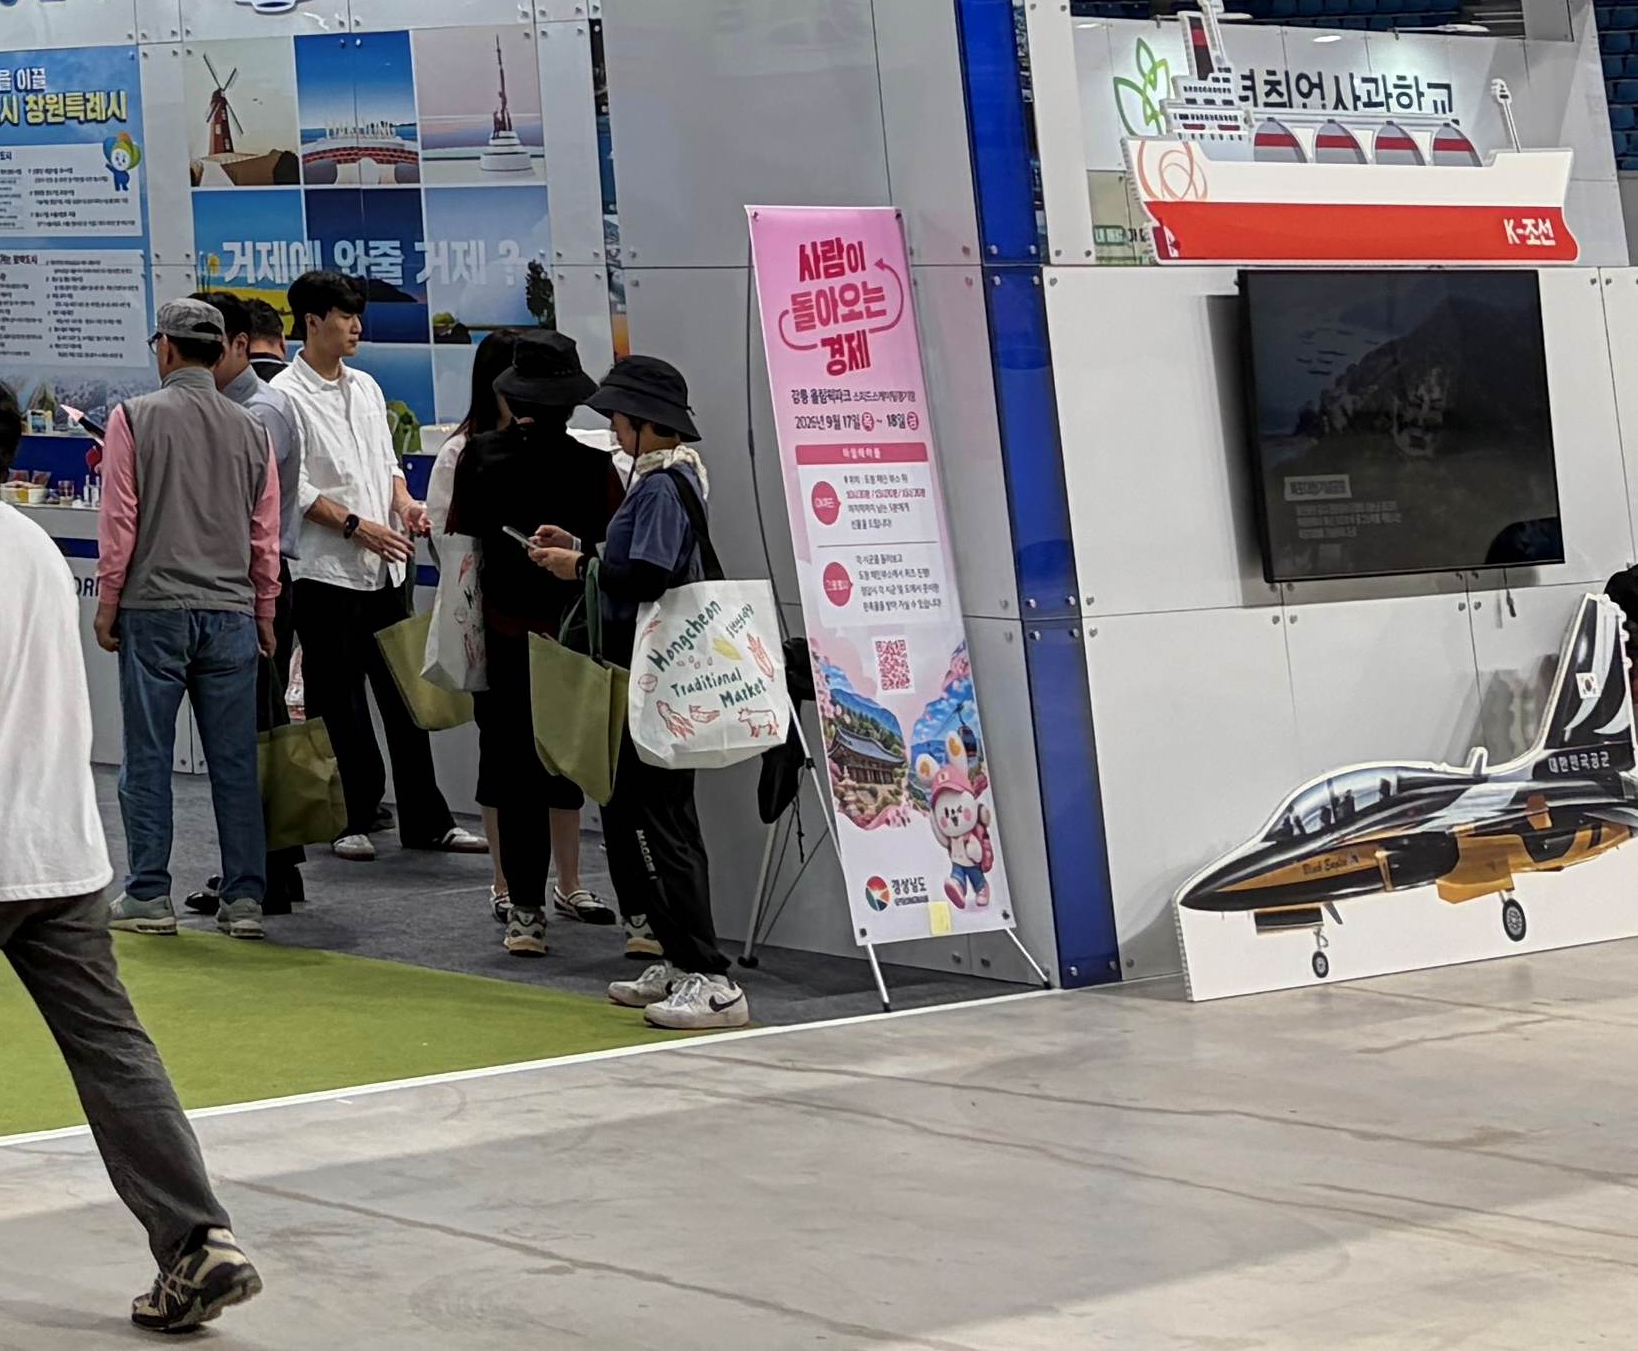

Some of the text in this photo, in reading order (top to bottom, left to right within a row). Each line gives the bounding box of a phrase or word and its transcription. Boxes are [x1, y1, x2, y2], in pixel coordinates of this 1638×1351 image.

[25, 90, 128, 123] 창원특례시
[1503, 217, 1556, 246] K-조선
[222, 240, 322, 285] 거제에
[415, 241, 488, 285] 거제
[799, 237, 866, 283] 사람이
[790, 280, 887, 333] 돌아오는
[821, 329, 871, 376] 경제
[646, 599, 723, 672] Hongcheon
[670, 667, 742, 698] Traditional
[719, 677, 767, 709] Market
